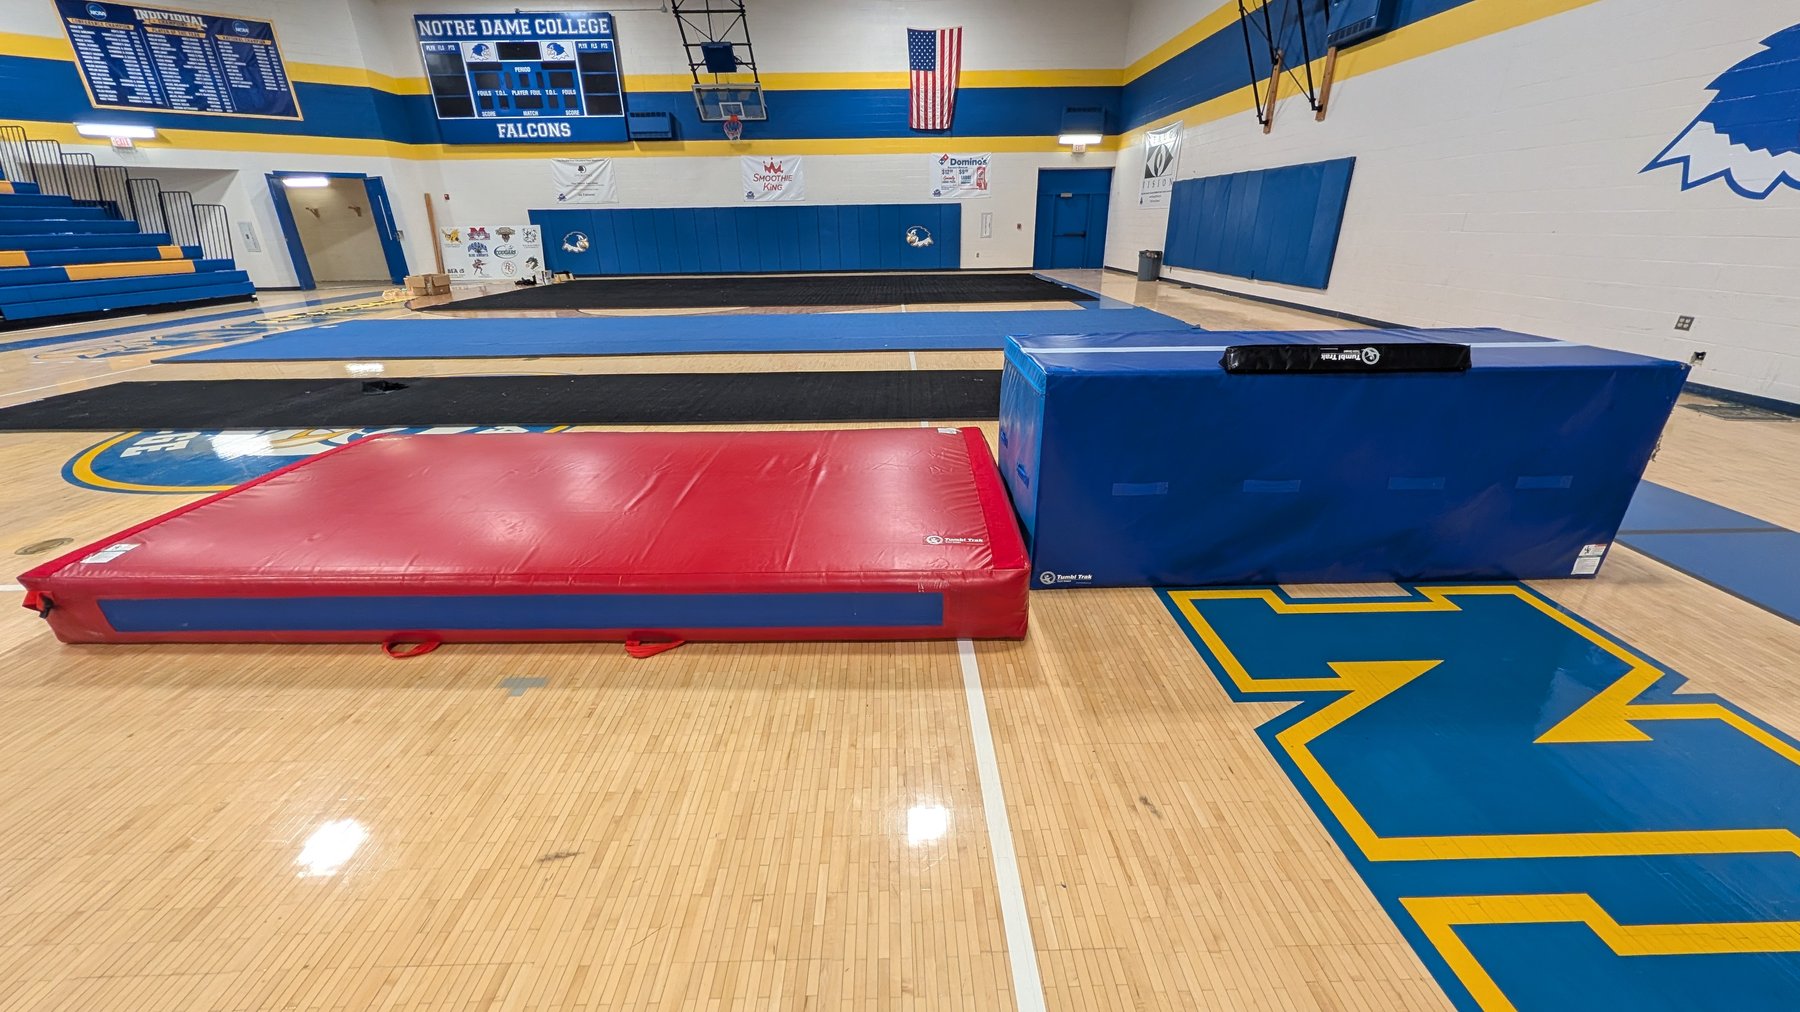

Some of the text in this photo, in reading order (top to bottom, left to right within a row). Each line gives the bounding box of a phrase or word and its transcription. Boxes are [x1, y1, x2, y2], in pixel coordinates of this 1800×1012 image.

[133, 8, 208, 28] INDIVIDUAL
[418, 18, 610, 36] NOTRE DAME COLLEGE
[497, 123, 571, 138] FALCONS
[950, 157, 987, 165] Domino's
[753, 173, 793, 182] SMOOTHIE
[1321, 353, 1361, 361] Tumbl Trak
